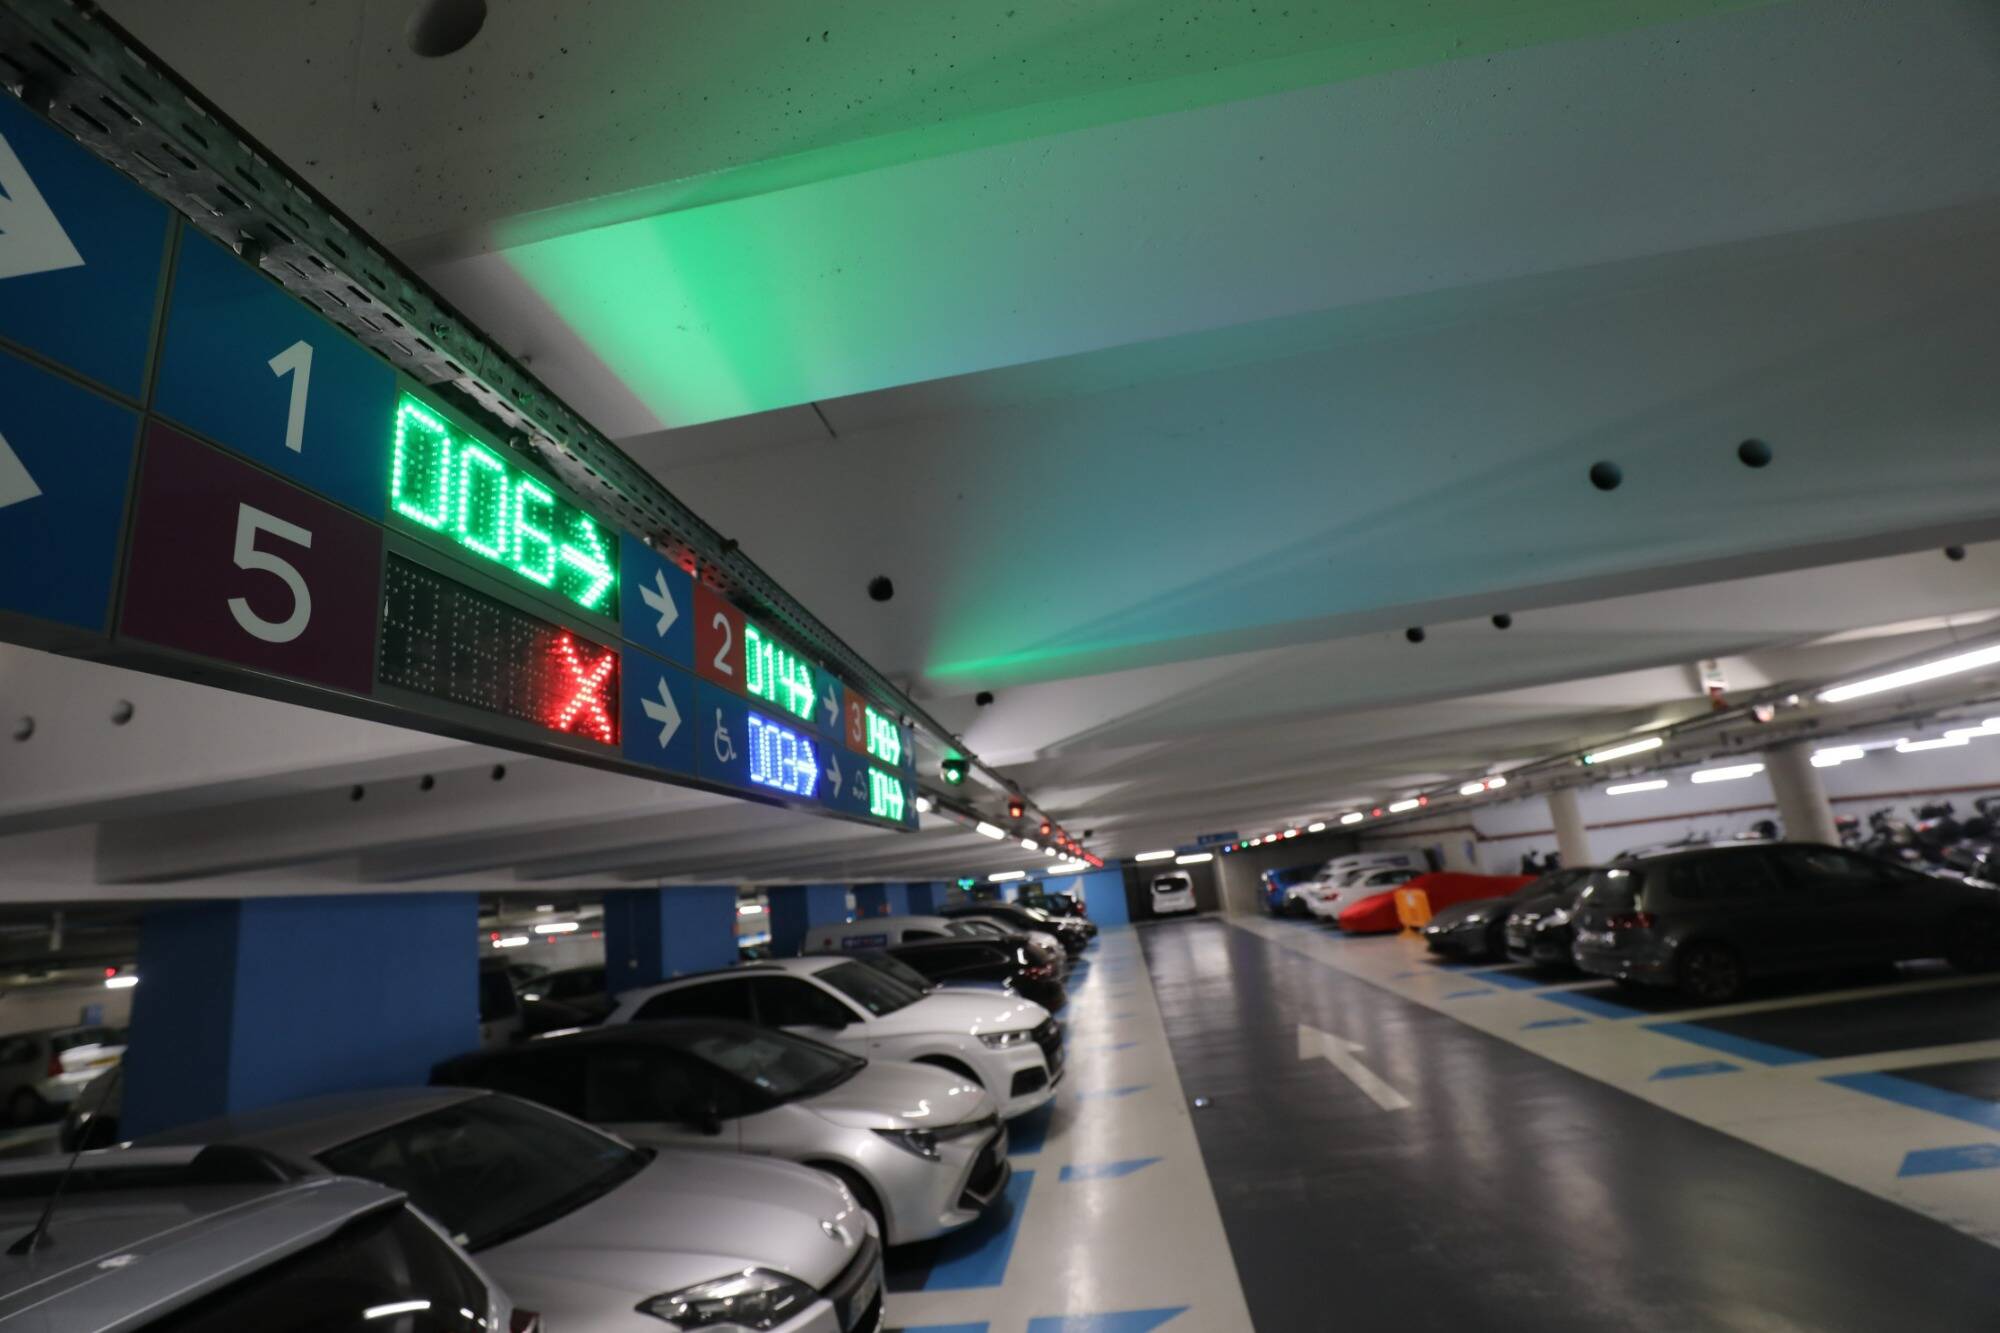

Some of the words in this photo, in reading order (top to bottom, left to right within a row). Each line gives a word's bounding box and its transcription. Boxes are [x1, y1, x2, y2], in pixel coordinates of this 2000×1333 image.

[267, 339, 313, 453] 1
[392, 401, 557, 588] 006
[227, 502, 312, 643] 5
[712, 612, 733, 676] 2
[851, 702, 861, 743] 3
